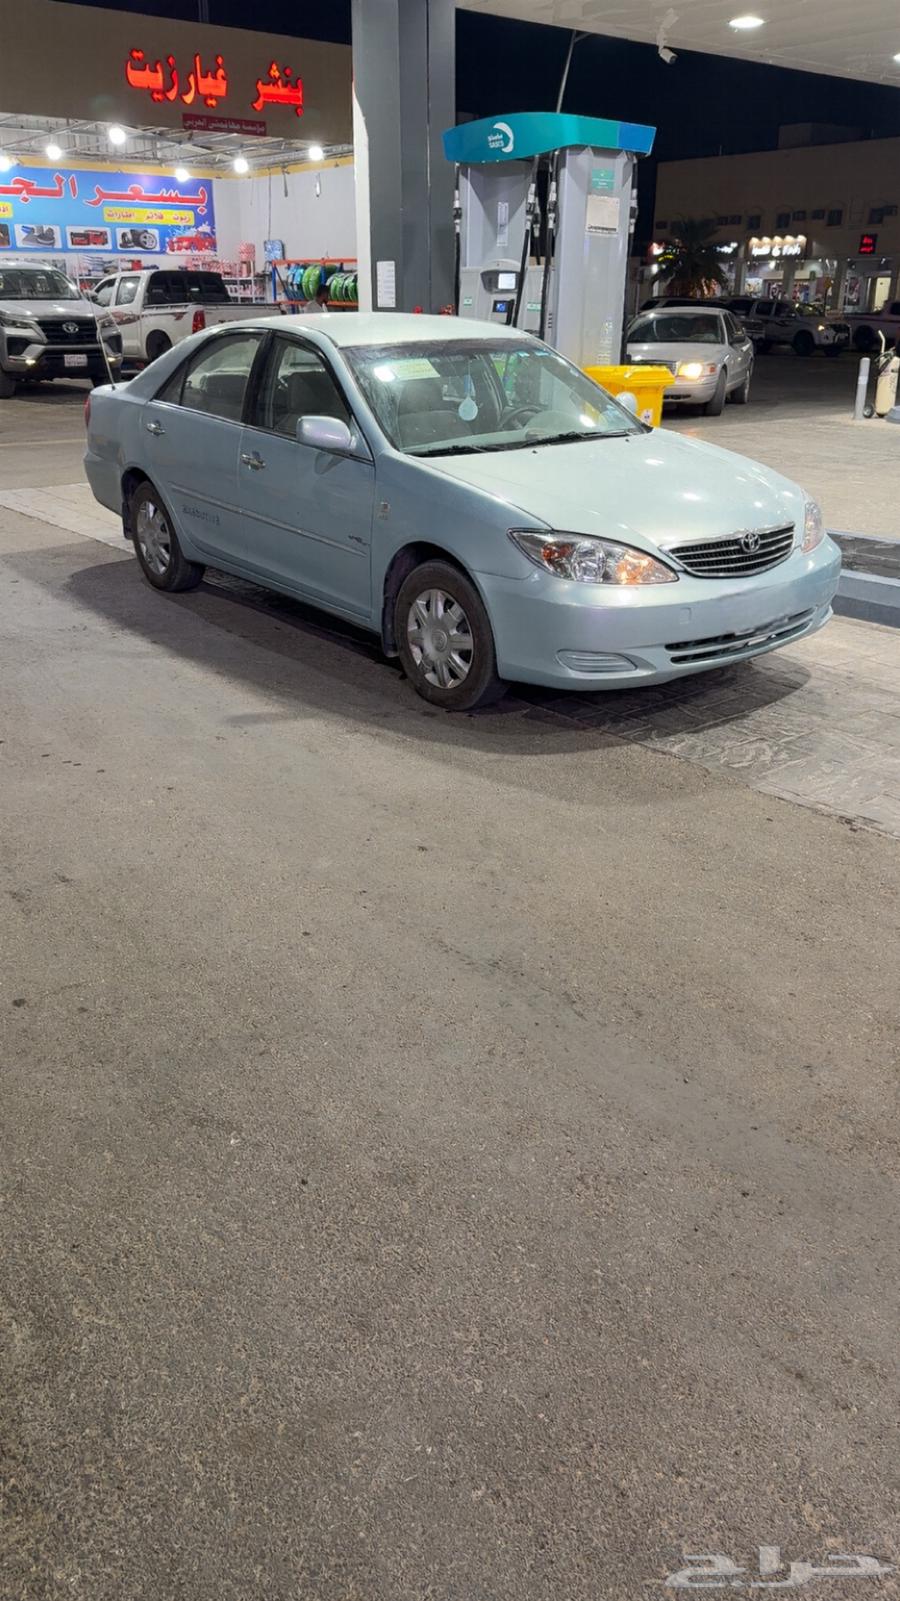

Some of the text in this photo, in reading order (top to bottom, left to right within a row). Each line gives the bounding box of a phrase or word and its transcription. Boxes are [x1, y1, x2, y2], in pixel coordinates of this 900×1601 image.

[126, 48, 303, 117] بنشر غيار زيت
[0, 172, 208, 215] بسعر الج
